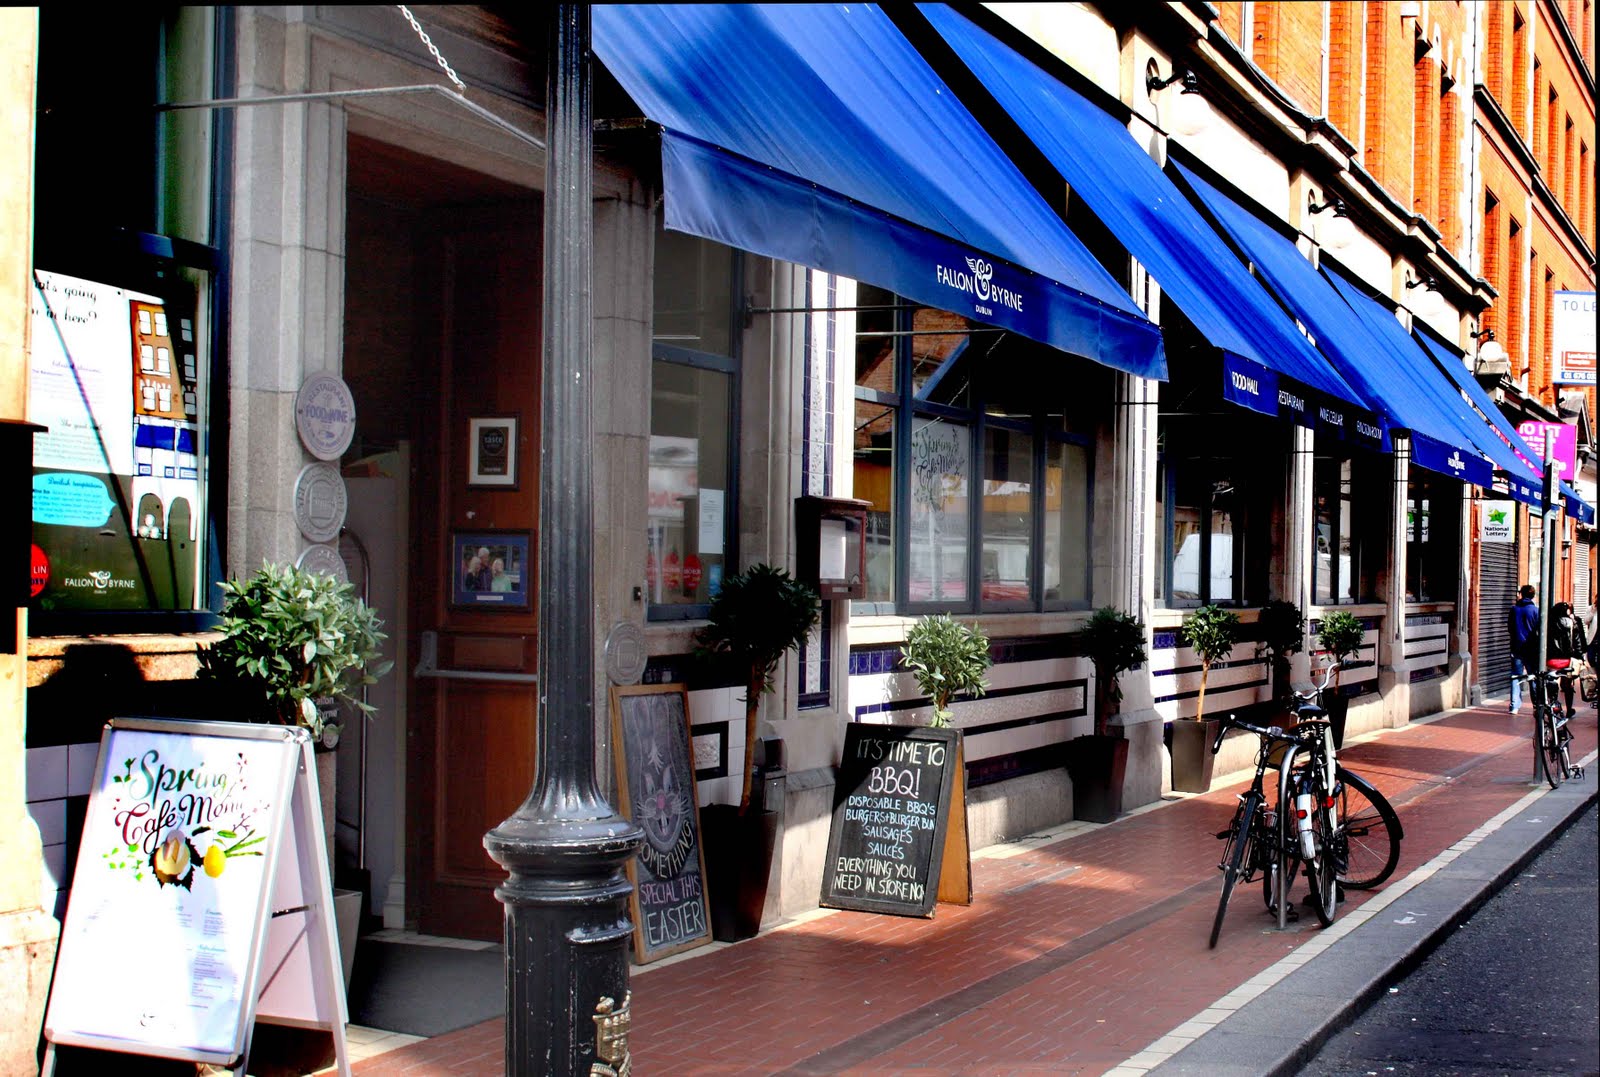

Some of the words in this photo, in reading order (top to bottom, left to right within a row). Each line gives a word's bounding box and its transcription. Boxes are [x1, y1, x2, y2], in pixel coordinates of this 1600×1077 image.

[64, 285, 97, 304] going
[937, 264, 974, 294] FALLON
[991, 284, 1024, 312] BYRNE
[64, 305, 98, 324] here?
[975, 304, 993, 317] DUBLIN
[1562, 300, 1578, 312] TO
[1231, 371, 1247, 391] FOOD
[1246, 378, 1259, 395] HALL
[1278, 389, 1305, 413] RESTAURANT
[1328, 411, 1344, 427] CELLAR
[1538, 424, 1562, 438] LT
[64, 578, 94, 587] FALLON
[108, 580, 135, 588] BYRNE
[857, 738, 884, 760] IT'S
[887, 740, 922, 765] TIME
[924, 742, 945, 766] TO
[129, 749, 227, 810] Spring
[867, 766, 921, 799] BBQ!
[848, 795, 902, 811] DISPOSABLE
[114, 798, 176, 855] Café
[863, 825, 913, 847] SAUSAGES
[641, 820, 694, 879] OMETHING
[866, 841, 905, 860] SAUCES
[837, 857, 894, 880] EVERYTHING
[895, 862, 917, 880] YOU
[640, 880, 680, 905] SPECIAL
[679, 874, 701, 899] THIS
[834, 875, 862, 890] NEED
[866, 876, 876, 893] IN
[878, 879, 910, 900] STORE
[646, 900, 705, 945] EASTER
